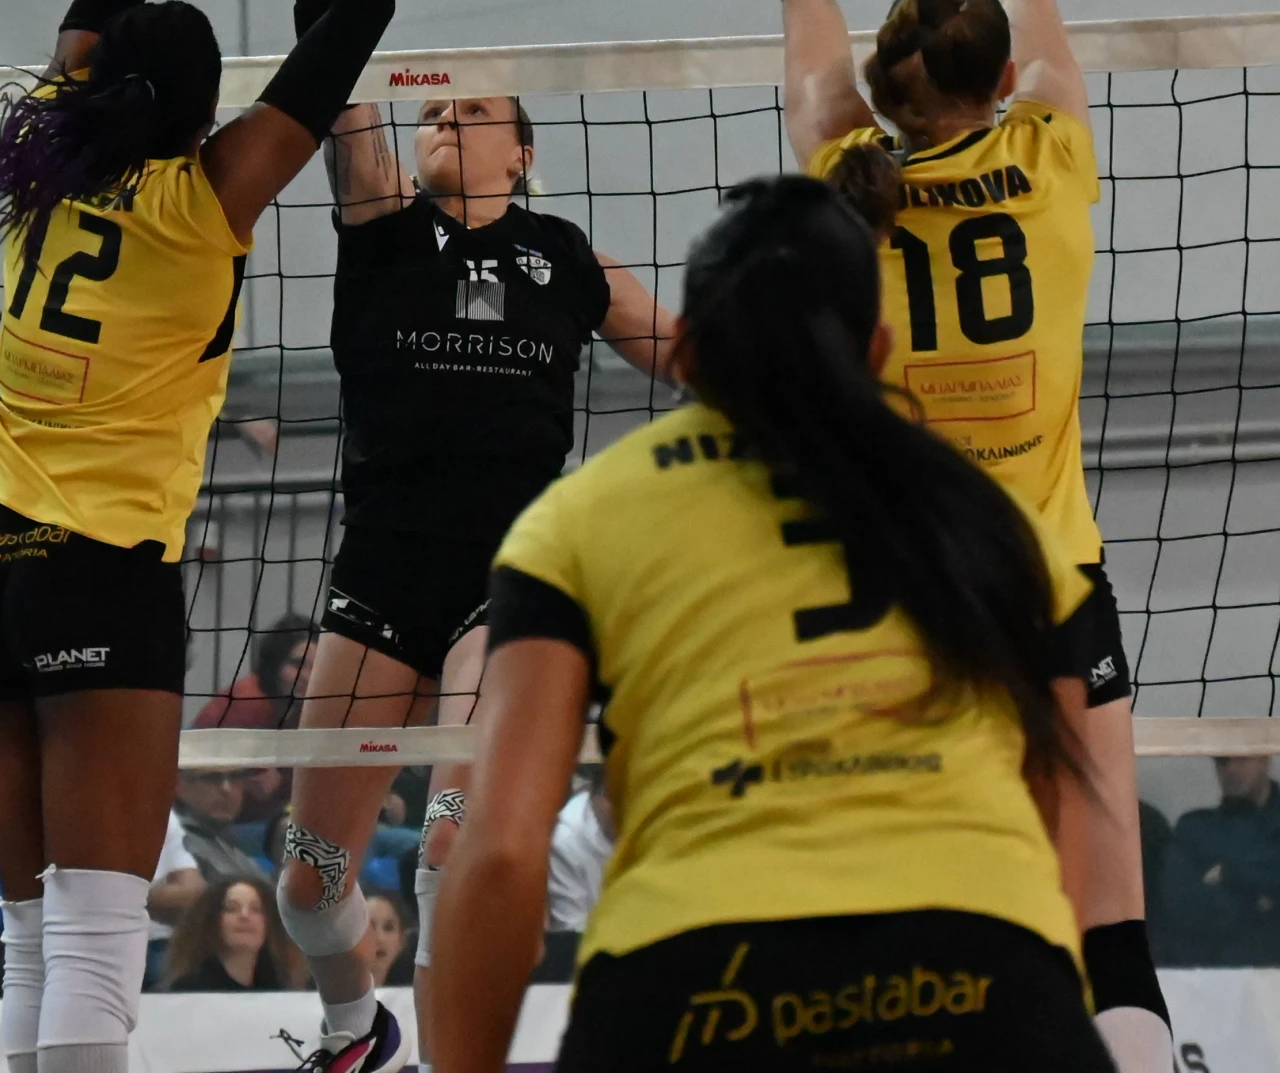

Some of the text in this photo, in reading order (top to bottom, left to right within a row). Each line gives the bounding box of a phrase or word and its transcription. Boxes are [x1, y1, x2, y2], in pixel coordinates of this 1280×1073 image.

[7, 208, 123, 345] 12
[889, 212, 1035, 352] 18
[396, 329, 554, 364] MORRISON
[414, 362, 431, 370] ALL
[432, 363, 451, 371] DAY
[33, 646, 111, 669] PLANET
